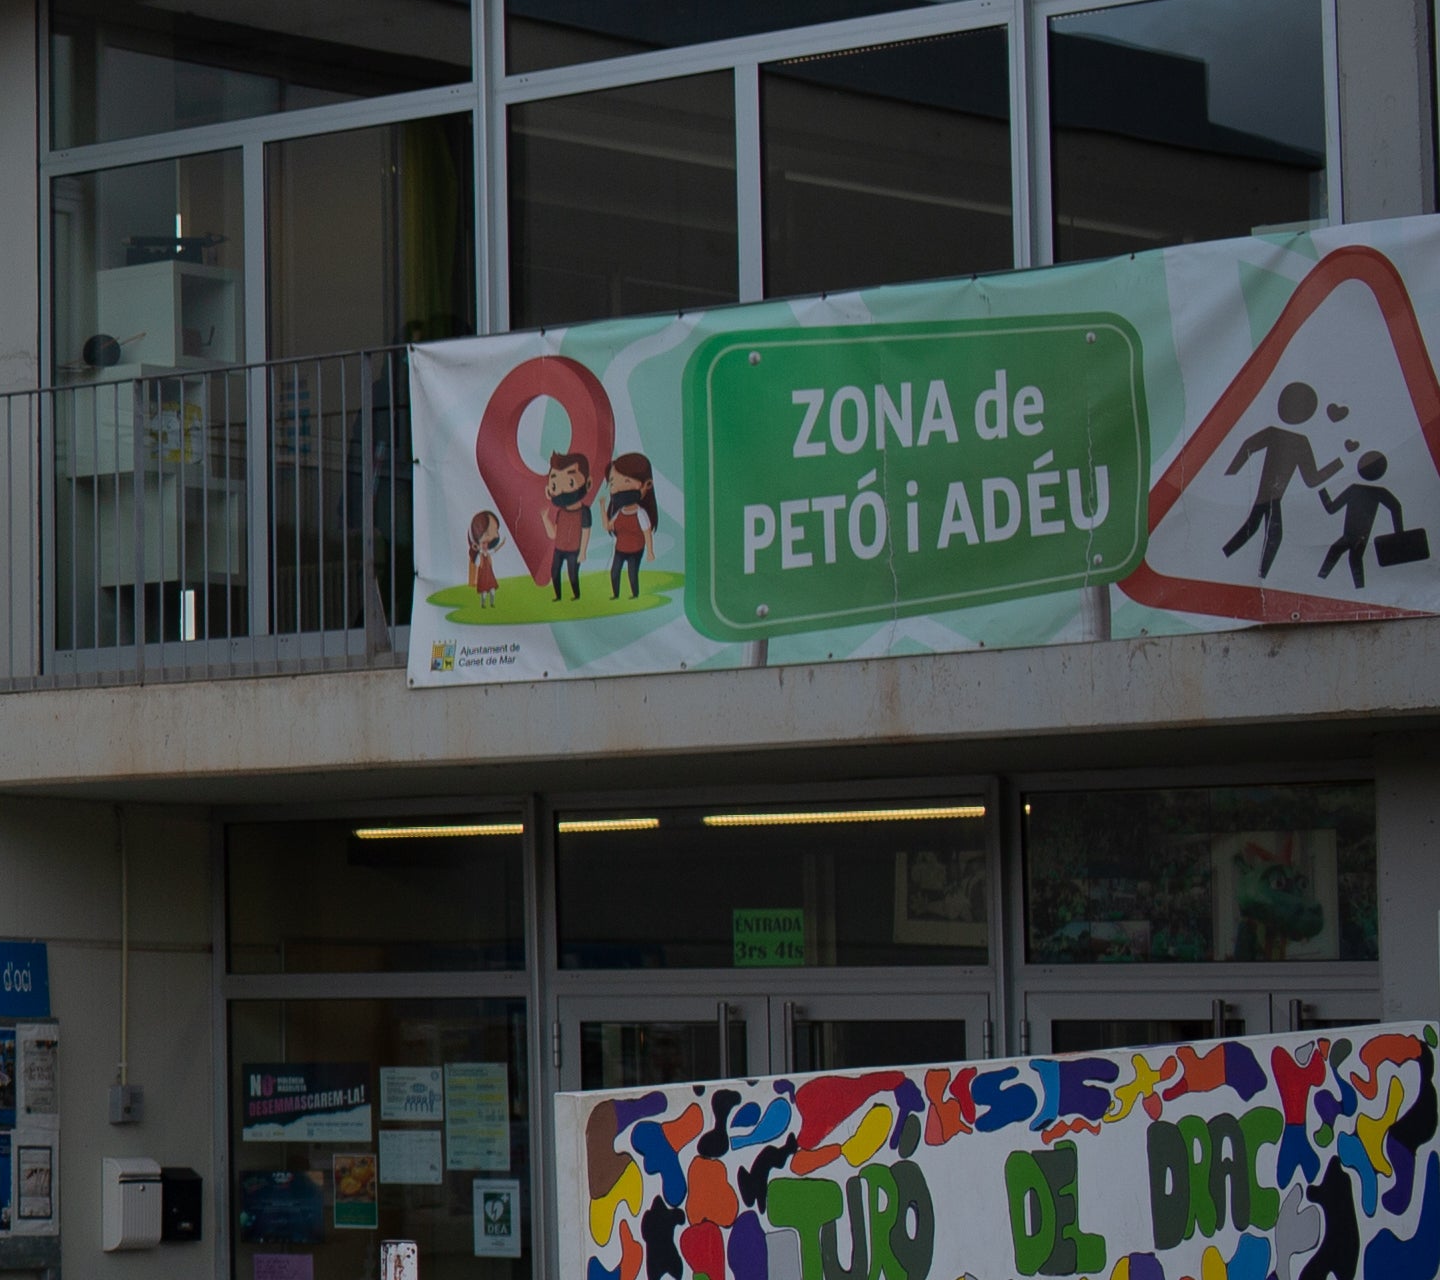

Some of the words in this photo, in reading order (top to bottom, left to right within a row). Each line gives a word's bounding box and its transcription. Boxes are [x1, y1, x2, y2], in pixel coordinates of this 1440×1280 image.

[790, 377, 959, 459] ZONA
[974, 369, 1045, 438] de
[744, 474, 887, 575] PETÓ
[907, 479, 920, 554] i
[936, 448, 1109, 550] ADÉU
[458, 656, 484, 667] Canet
[486, 657, 497, 666] de
[499, 656, 516, 665] Mar
[460, 644, 507, 656] Ajuntament
[509, 642, 520, 652] de
[736, 917, 802, 933] ENTRADA
[3, 962, 34, 993] d'oci
[250, 1073, 274, 1097] NO
[1004, 1140, 1107, 1277] DEL
[1146, 1106, 1285, 1250] DRAC
